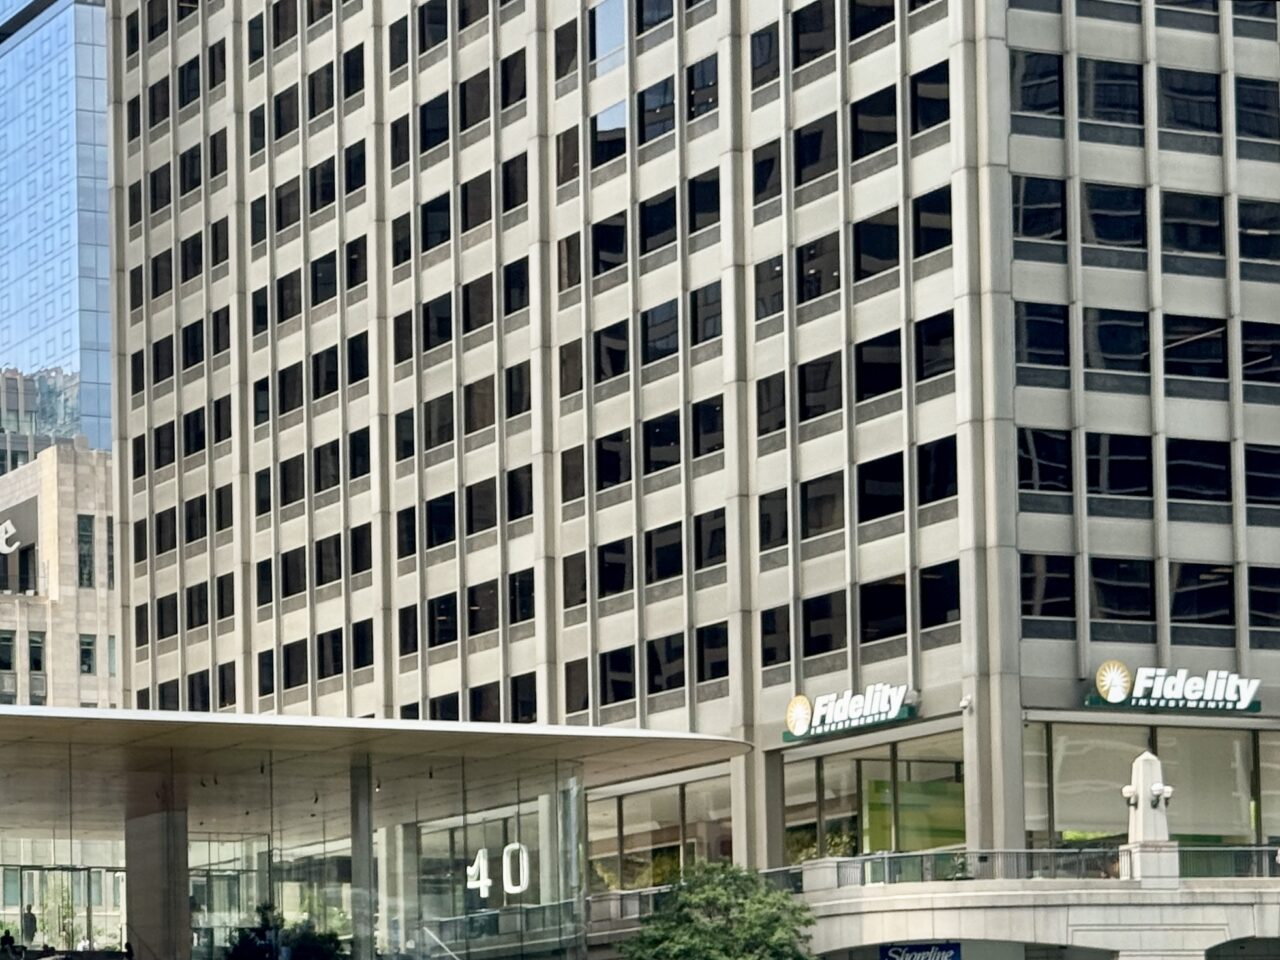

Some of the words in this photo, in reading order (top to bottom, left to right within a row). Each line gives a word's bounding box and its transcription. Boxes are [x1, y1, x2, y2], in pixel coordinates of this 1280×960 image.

[811, 682, 907, 727] Fidelity
[1131, 667, 1261, 710] Fidelity
[1131, 698, 1234, 710] INVESTMENTS
[466, 842, 529, 898] 40
